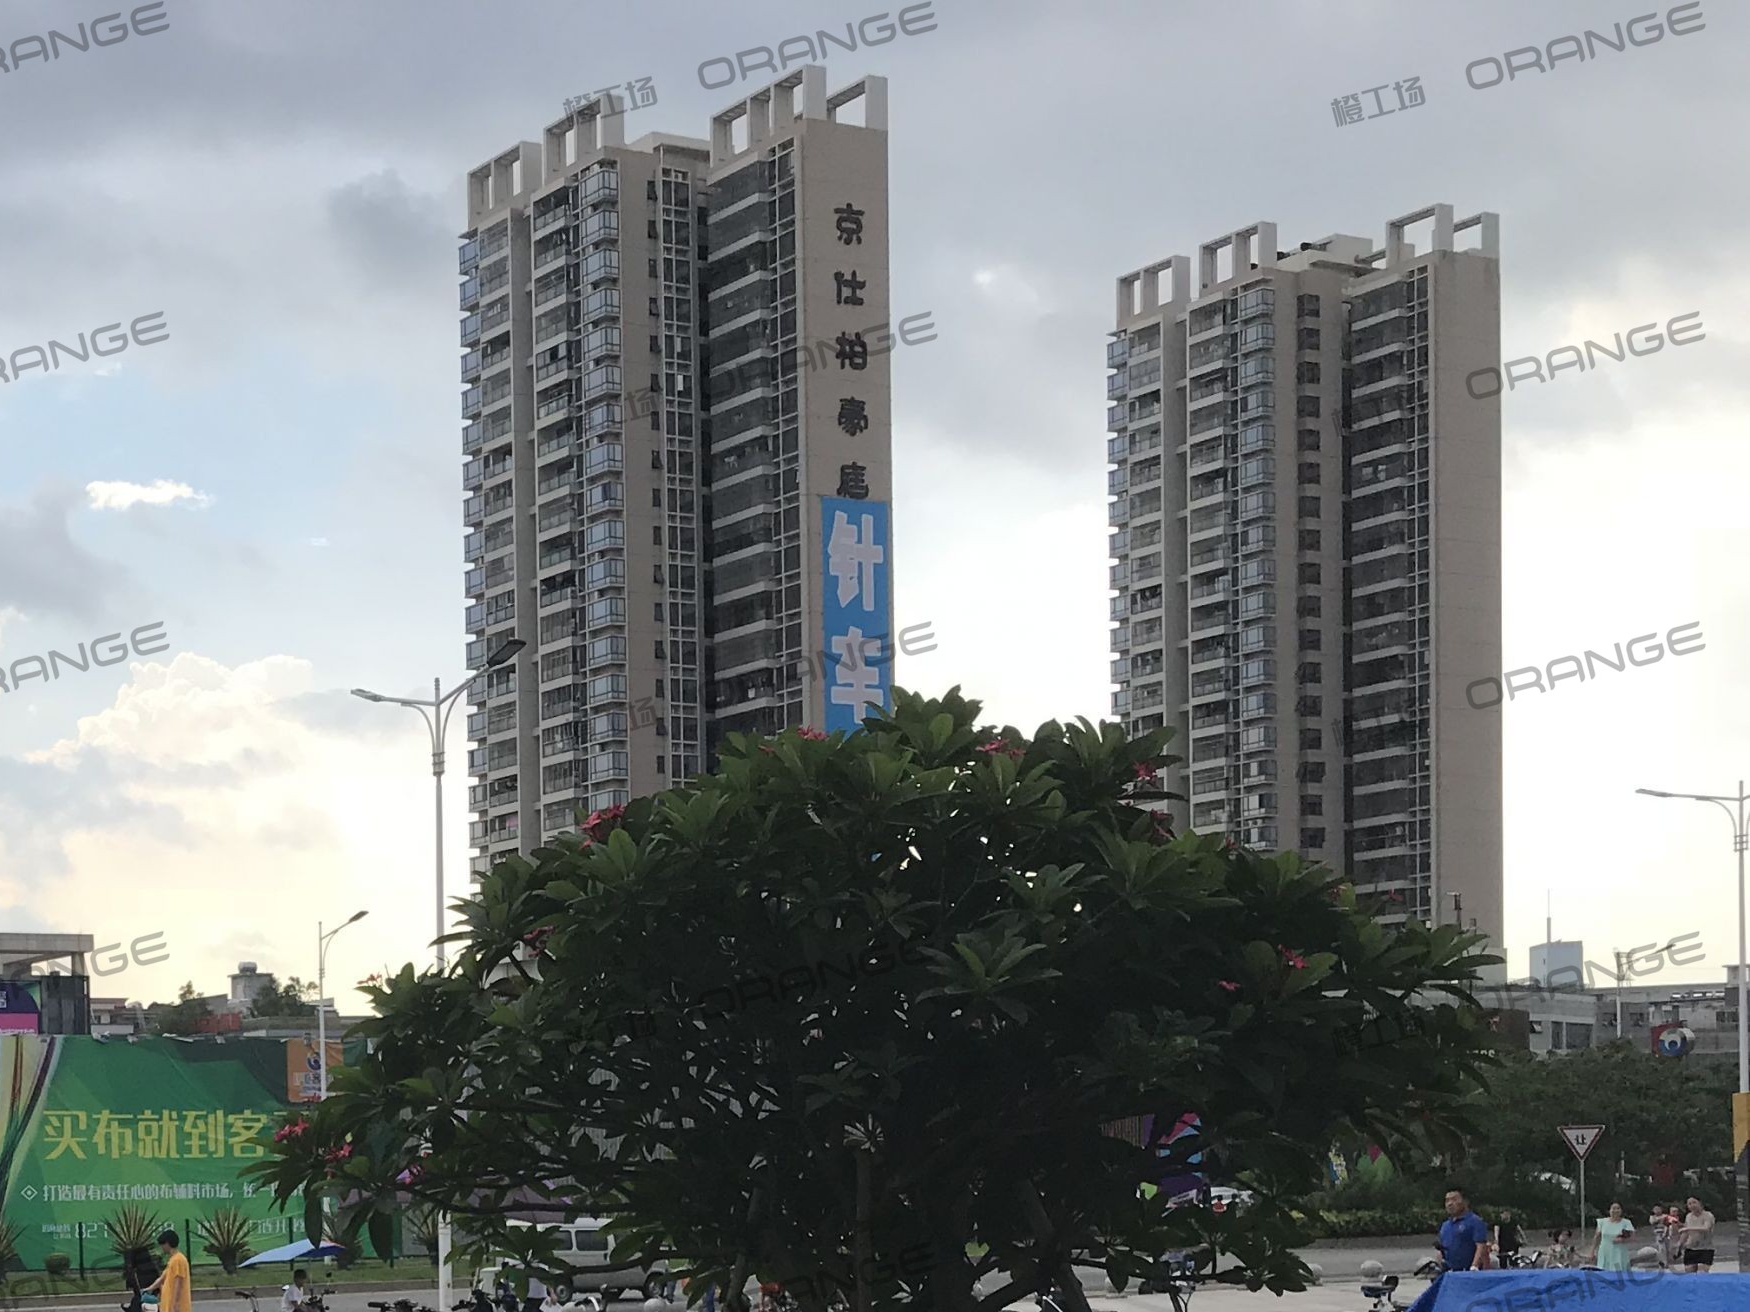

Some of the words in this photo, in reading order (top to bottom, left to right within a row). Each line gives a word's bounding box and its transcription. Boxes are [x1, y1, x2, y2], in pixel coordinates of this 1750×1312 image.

[833, 202, 869, 498] 京仕柏豪庭
[827, 509, 884, 726] 针车
[43, 1108, 310, 1160] 买布就到客
